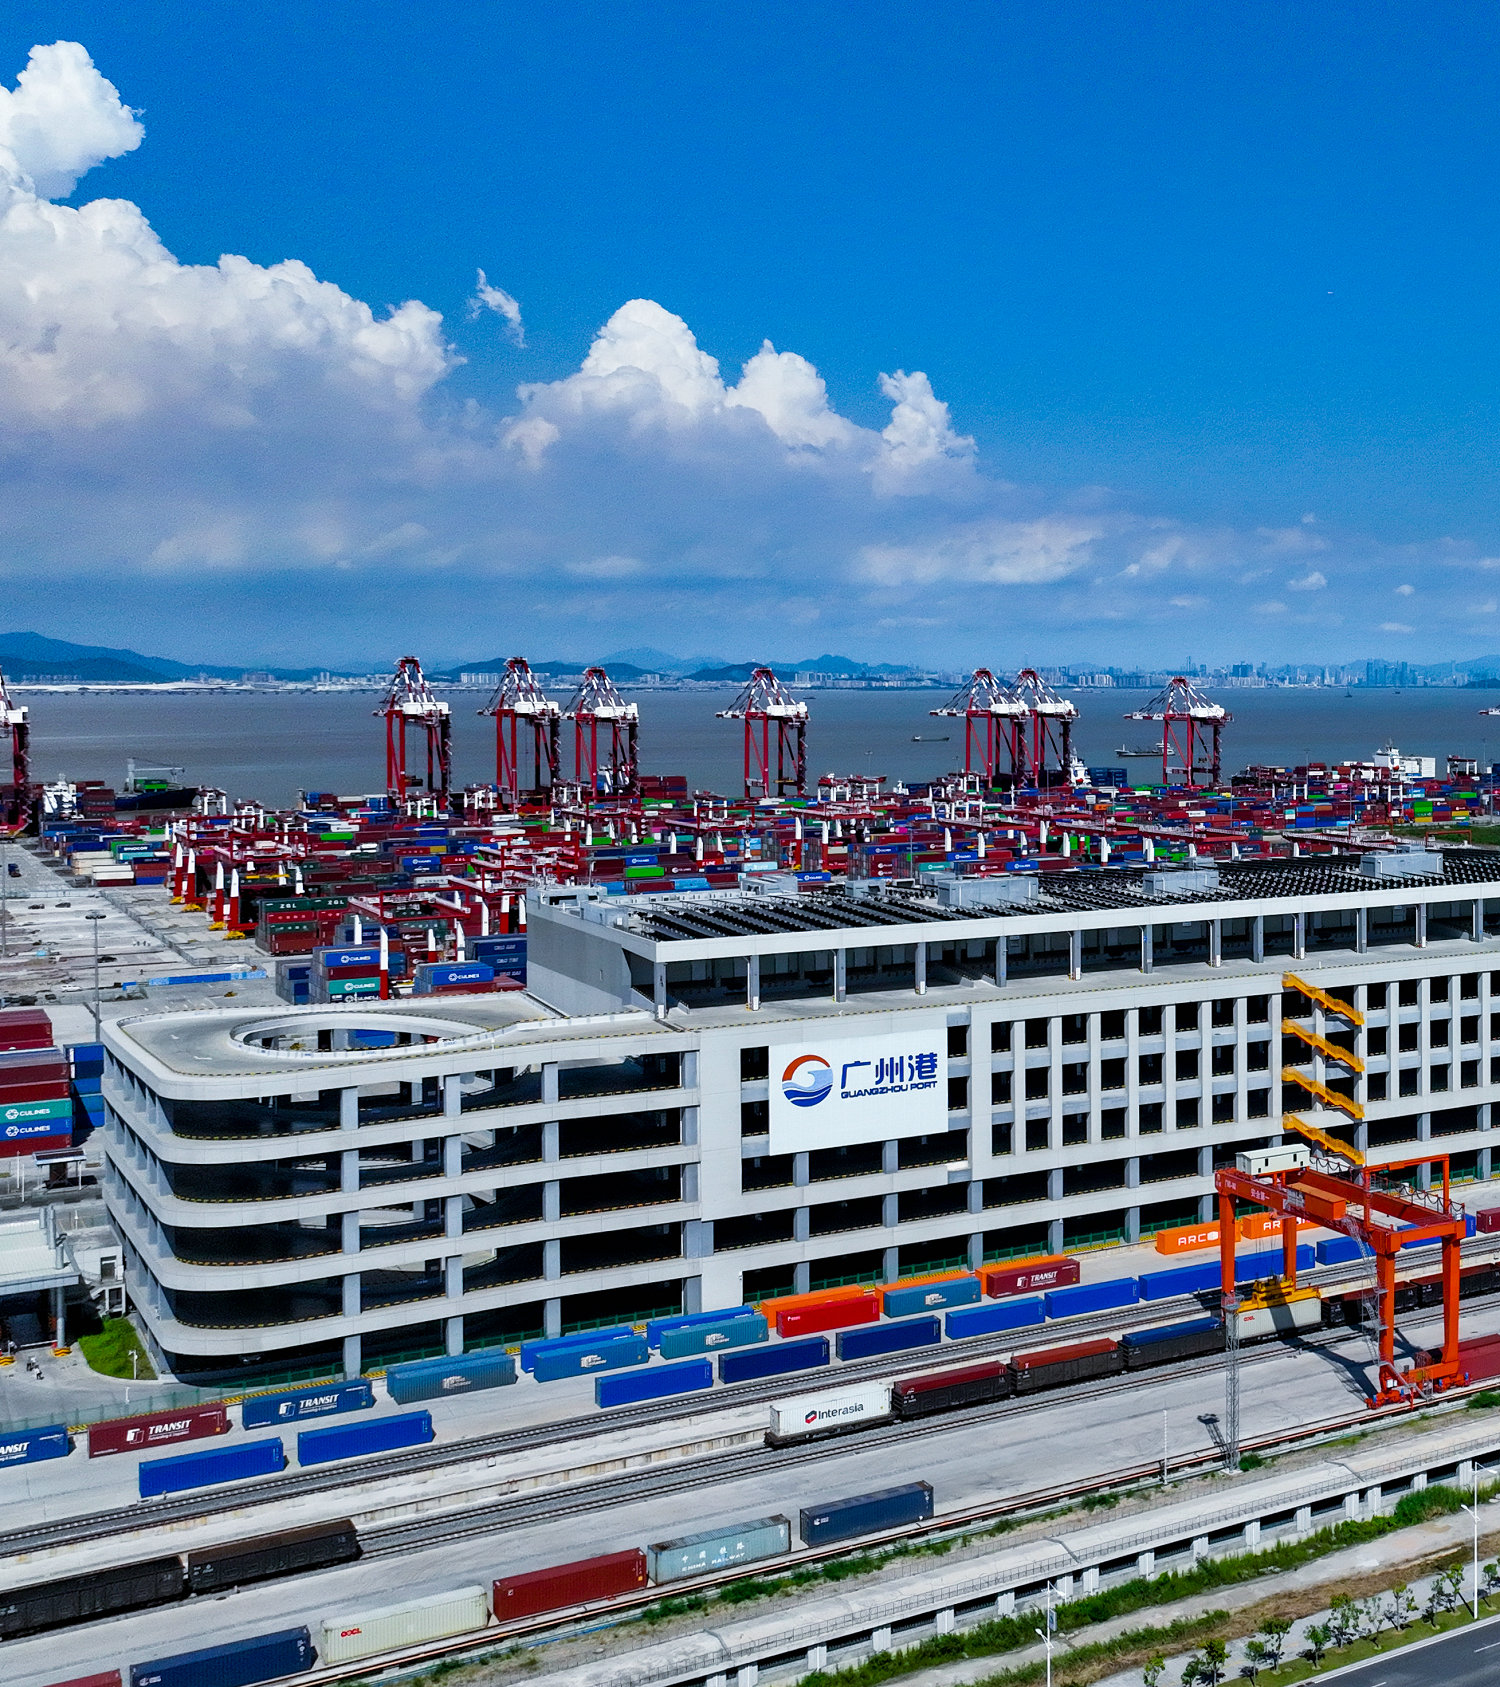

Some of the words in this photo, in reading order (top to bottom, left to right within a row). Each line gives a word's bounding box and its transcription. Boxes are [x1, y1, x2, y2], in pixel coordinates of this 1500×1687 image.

[840, 1052, 938, 1089] 广州港
[840, 1083, 909, 1099] GUANGZHOU
[910, 1081, 938, 1091] PORT
[19, 1108, 51, 1117] CULINES
[19, 1125, 51, 1134] CULINES
[1031, 1271, 1058, 1282] TRANSIT
[299, 1393, 340, 1409] TRANSIT
[818, 1402, 864, 1420] Interasia
[148, 1419, 192, 1435] TRANSIT
[340, 1627, 362, 1638] OOCL
